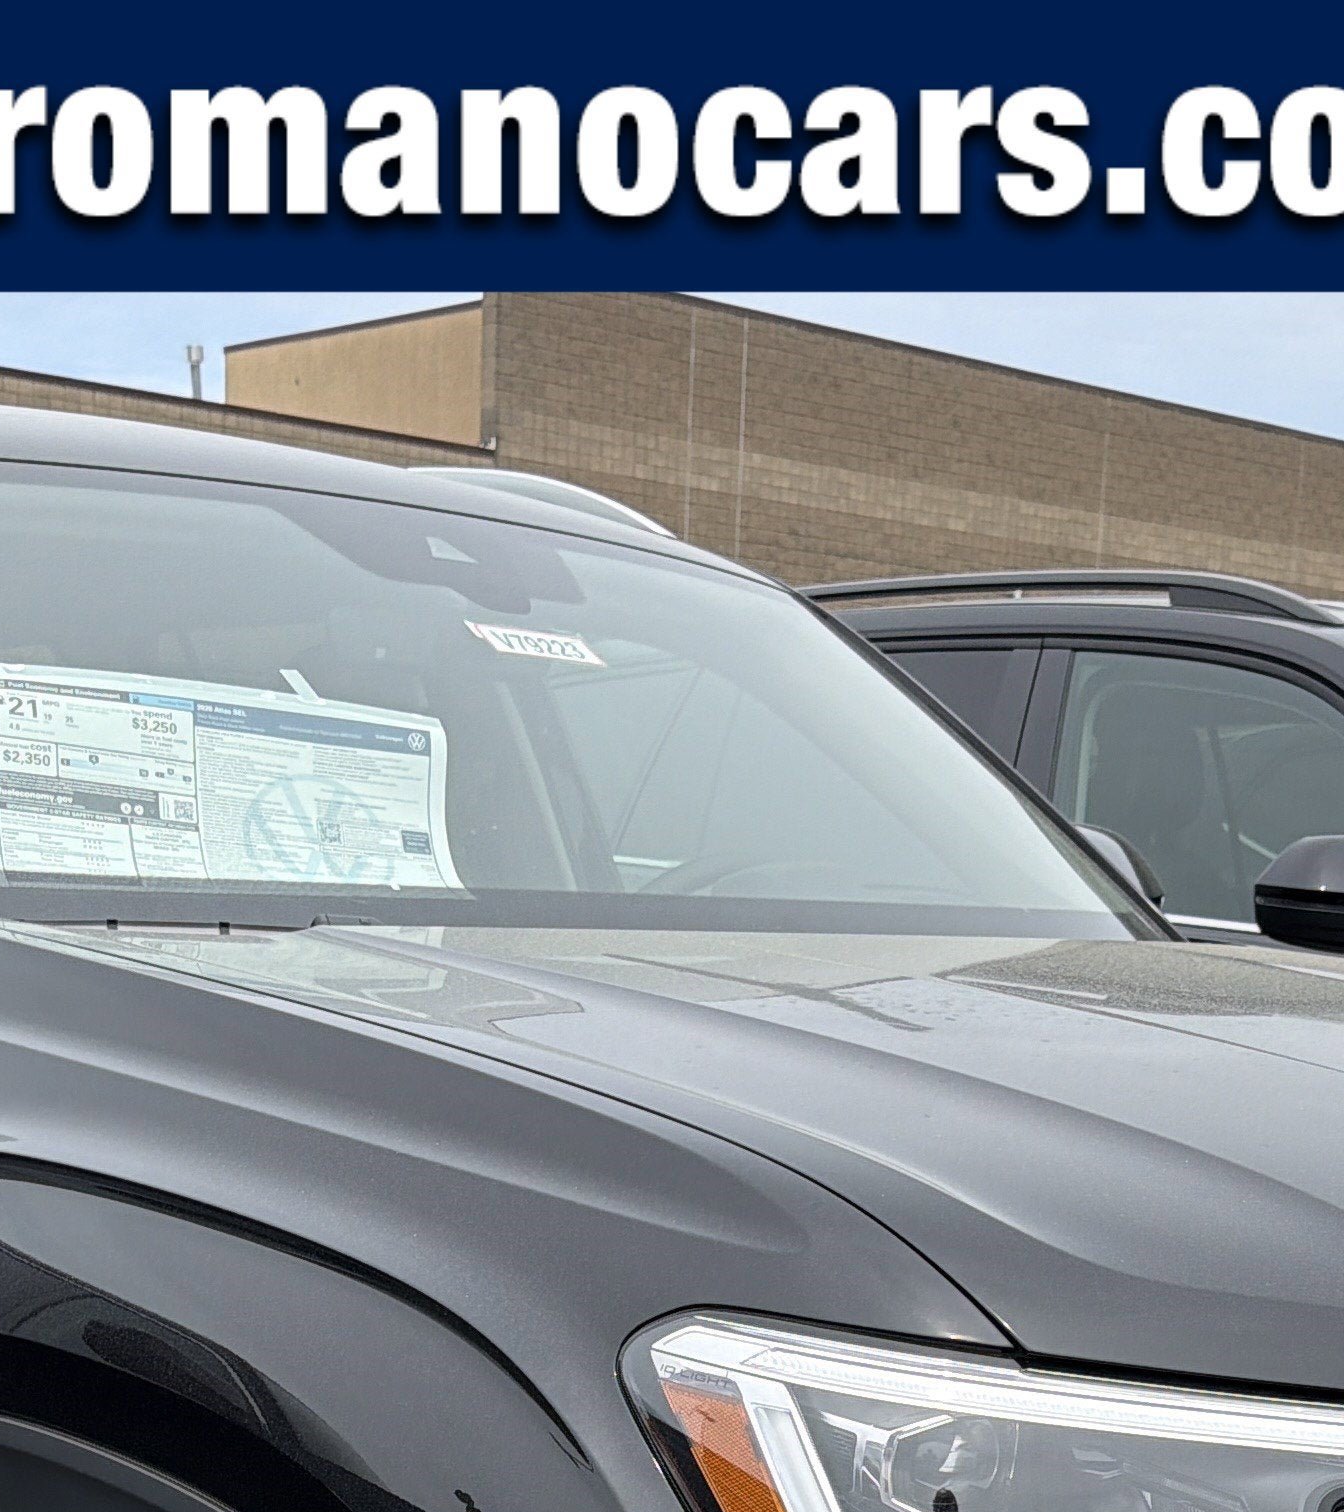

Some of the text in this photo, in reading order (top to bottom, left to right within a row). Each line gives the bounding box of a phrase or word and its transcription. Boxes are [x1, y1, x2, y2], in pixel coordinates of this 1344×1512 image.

[489, 629, 586, 660] V79223
[8, 696, 38, 718] 21
[143, 710, 173, 721] spend
[132, 717, 178, 735] $3,250
[3, 749, 51, 767] $2,350
